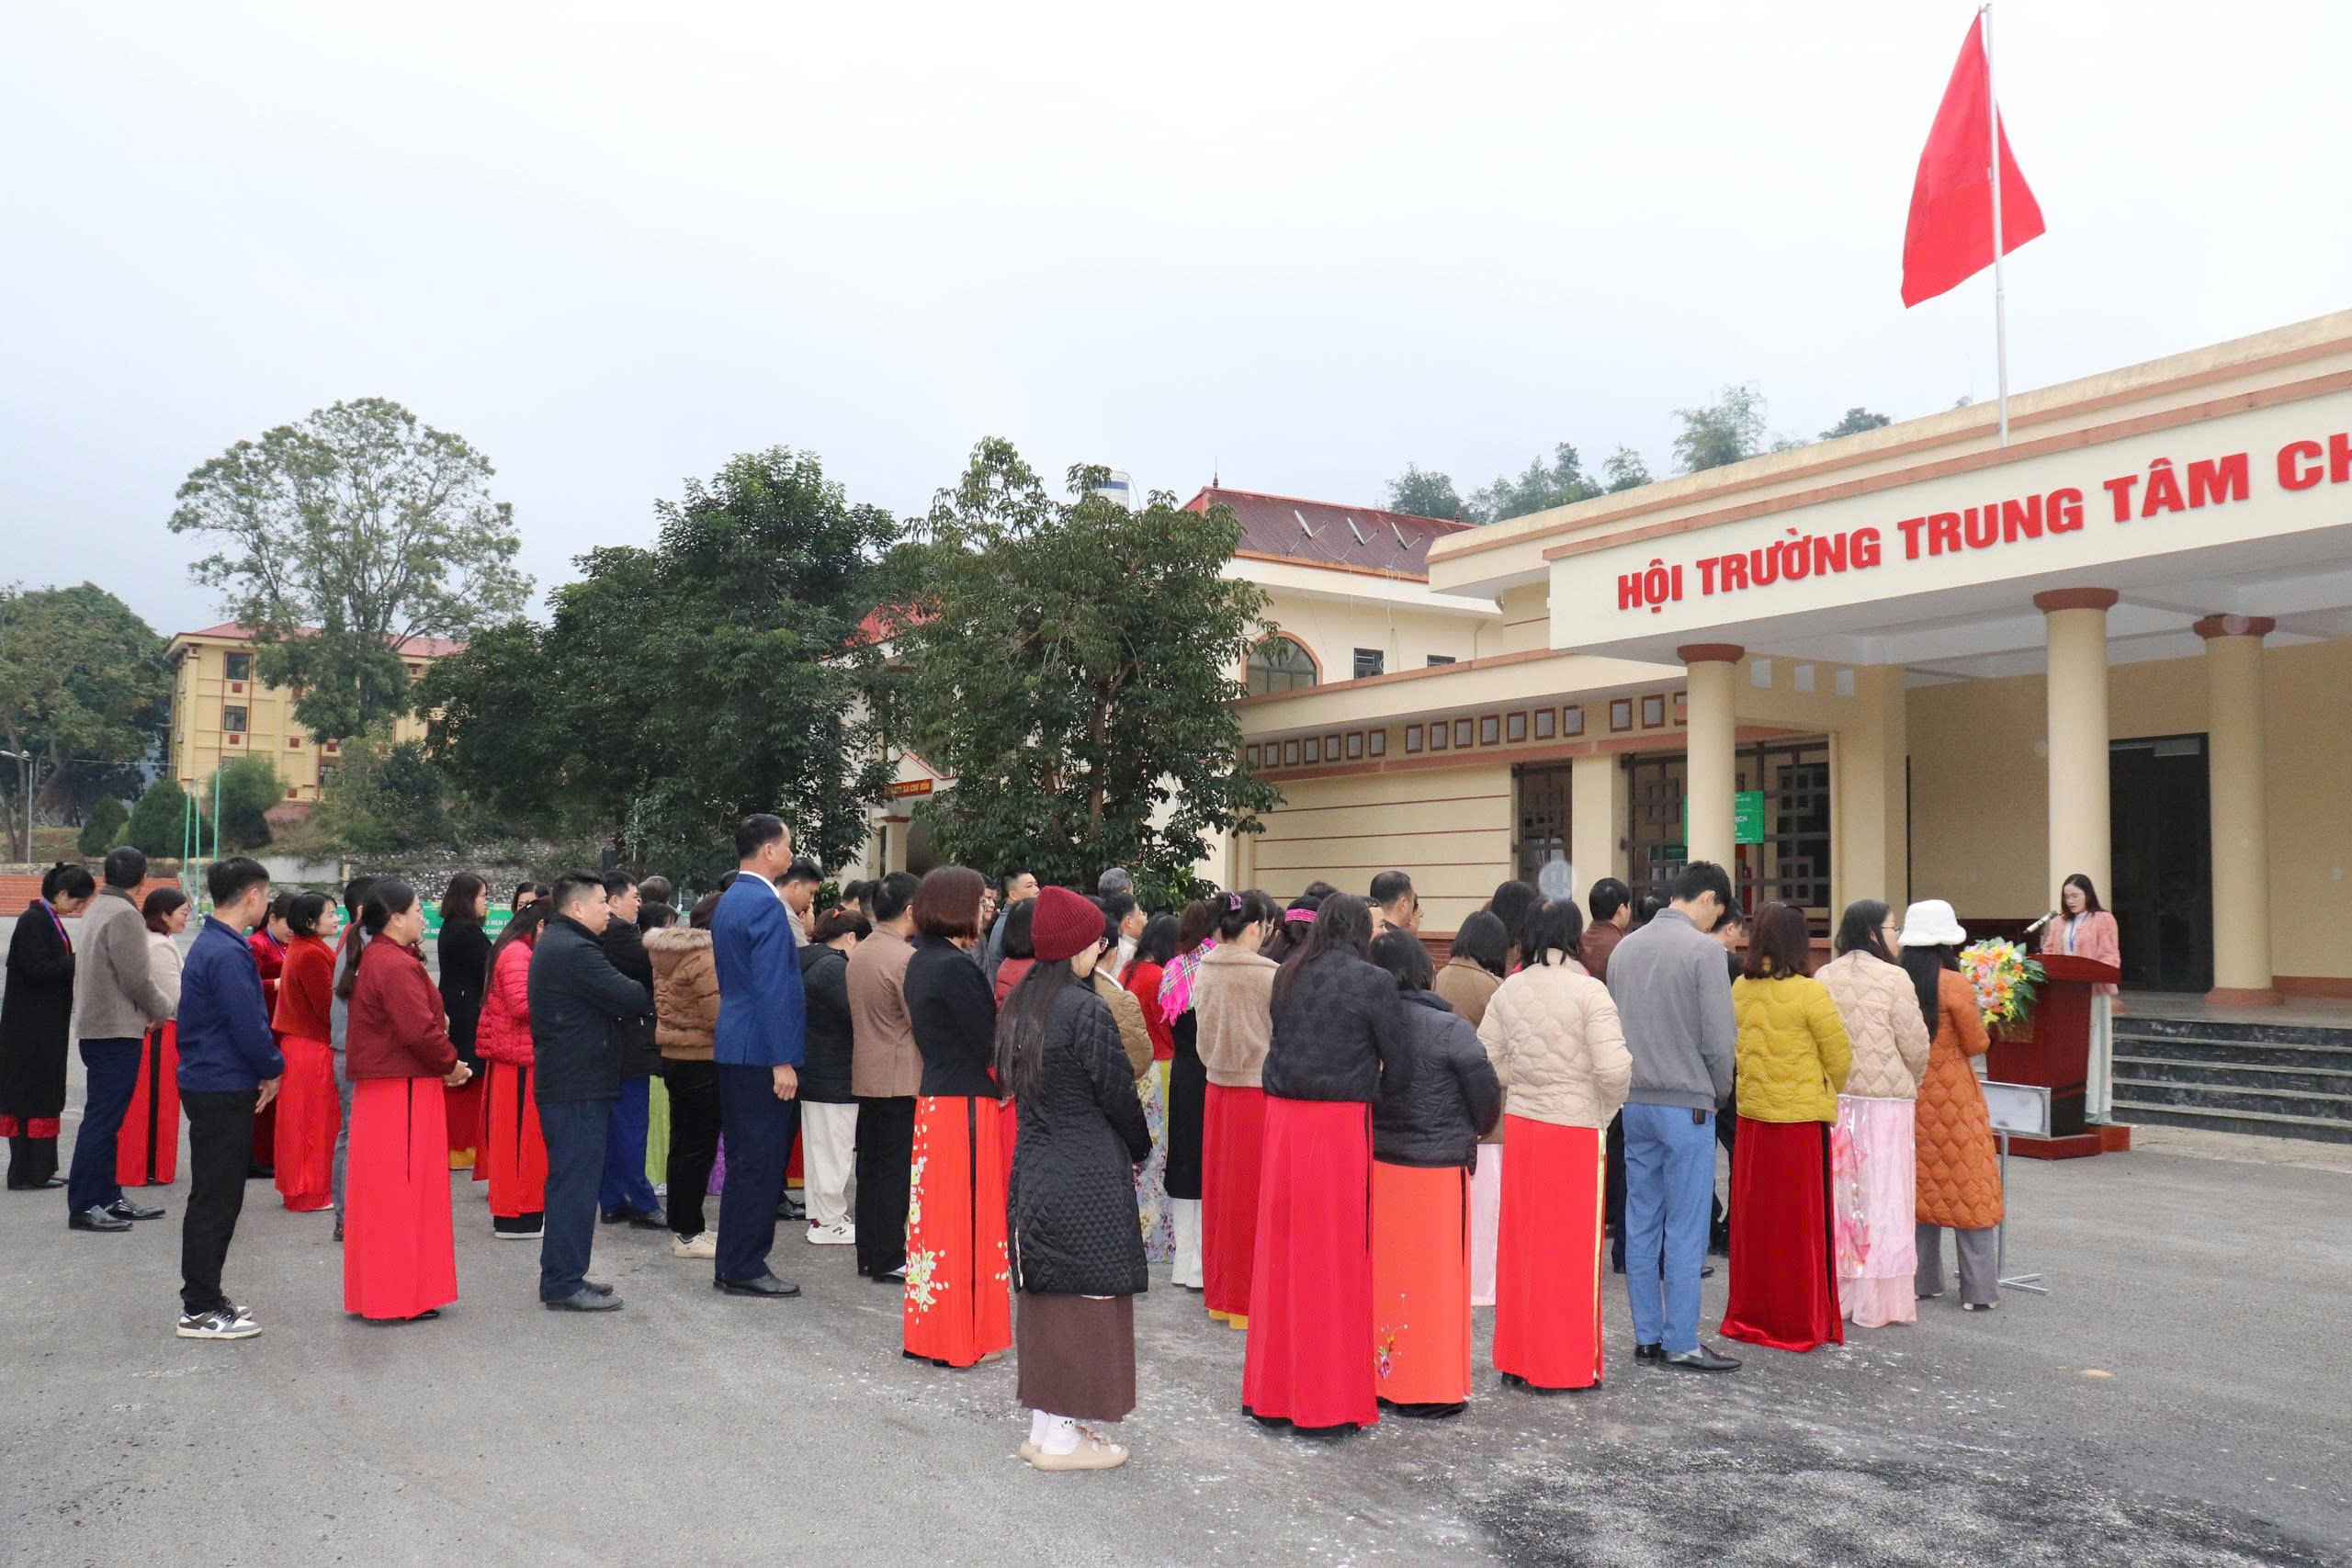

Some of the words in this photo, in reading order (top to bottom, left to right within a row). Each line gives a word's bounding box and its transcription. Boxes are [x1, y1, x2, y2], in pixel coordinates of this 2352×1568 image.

[1618, 558, 1683, 613] HỘI
[1696, 527, 1881, 594] TRƯỜNG
[1897, 488, 2084, 559] TRUNG
[2103, 453, 2250, 522] TÂM
